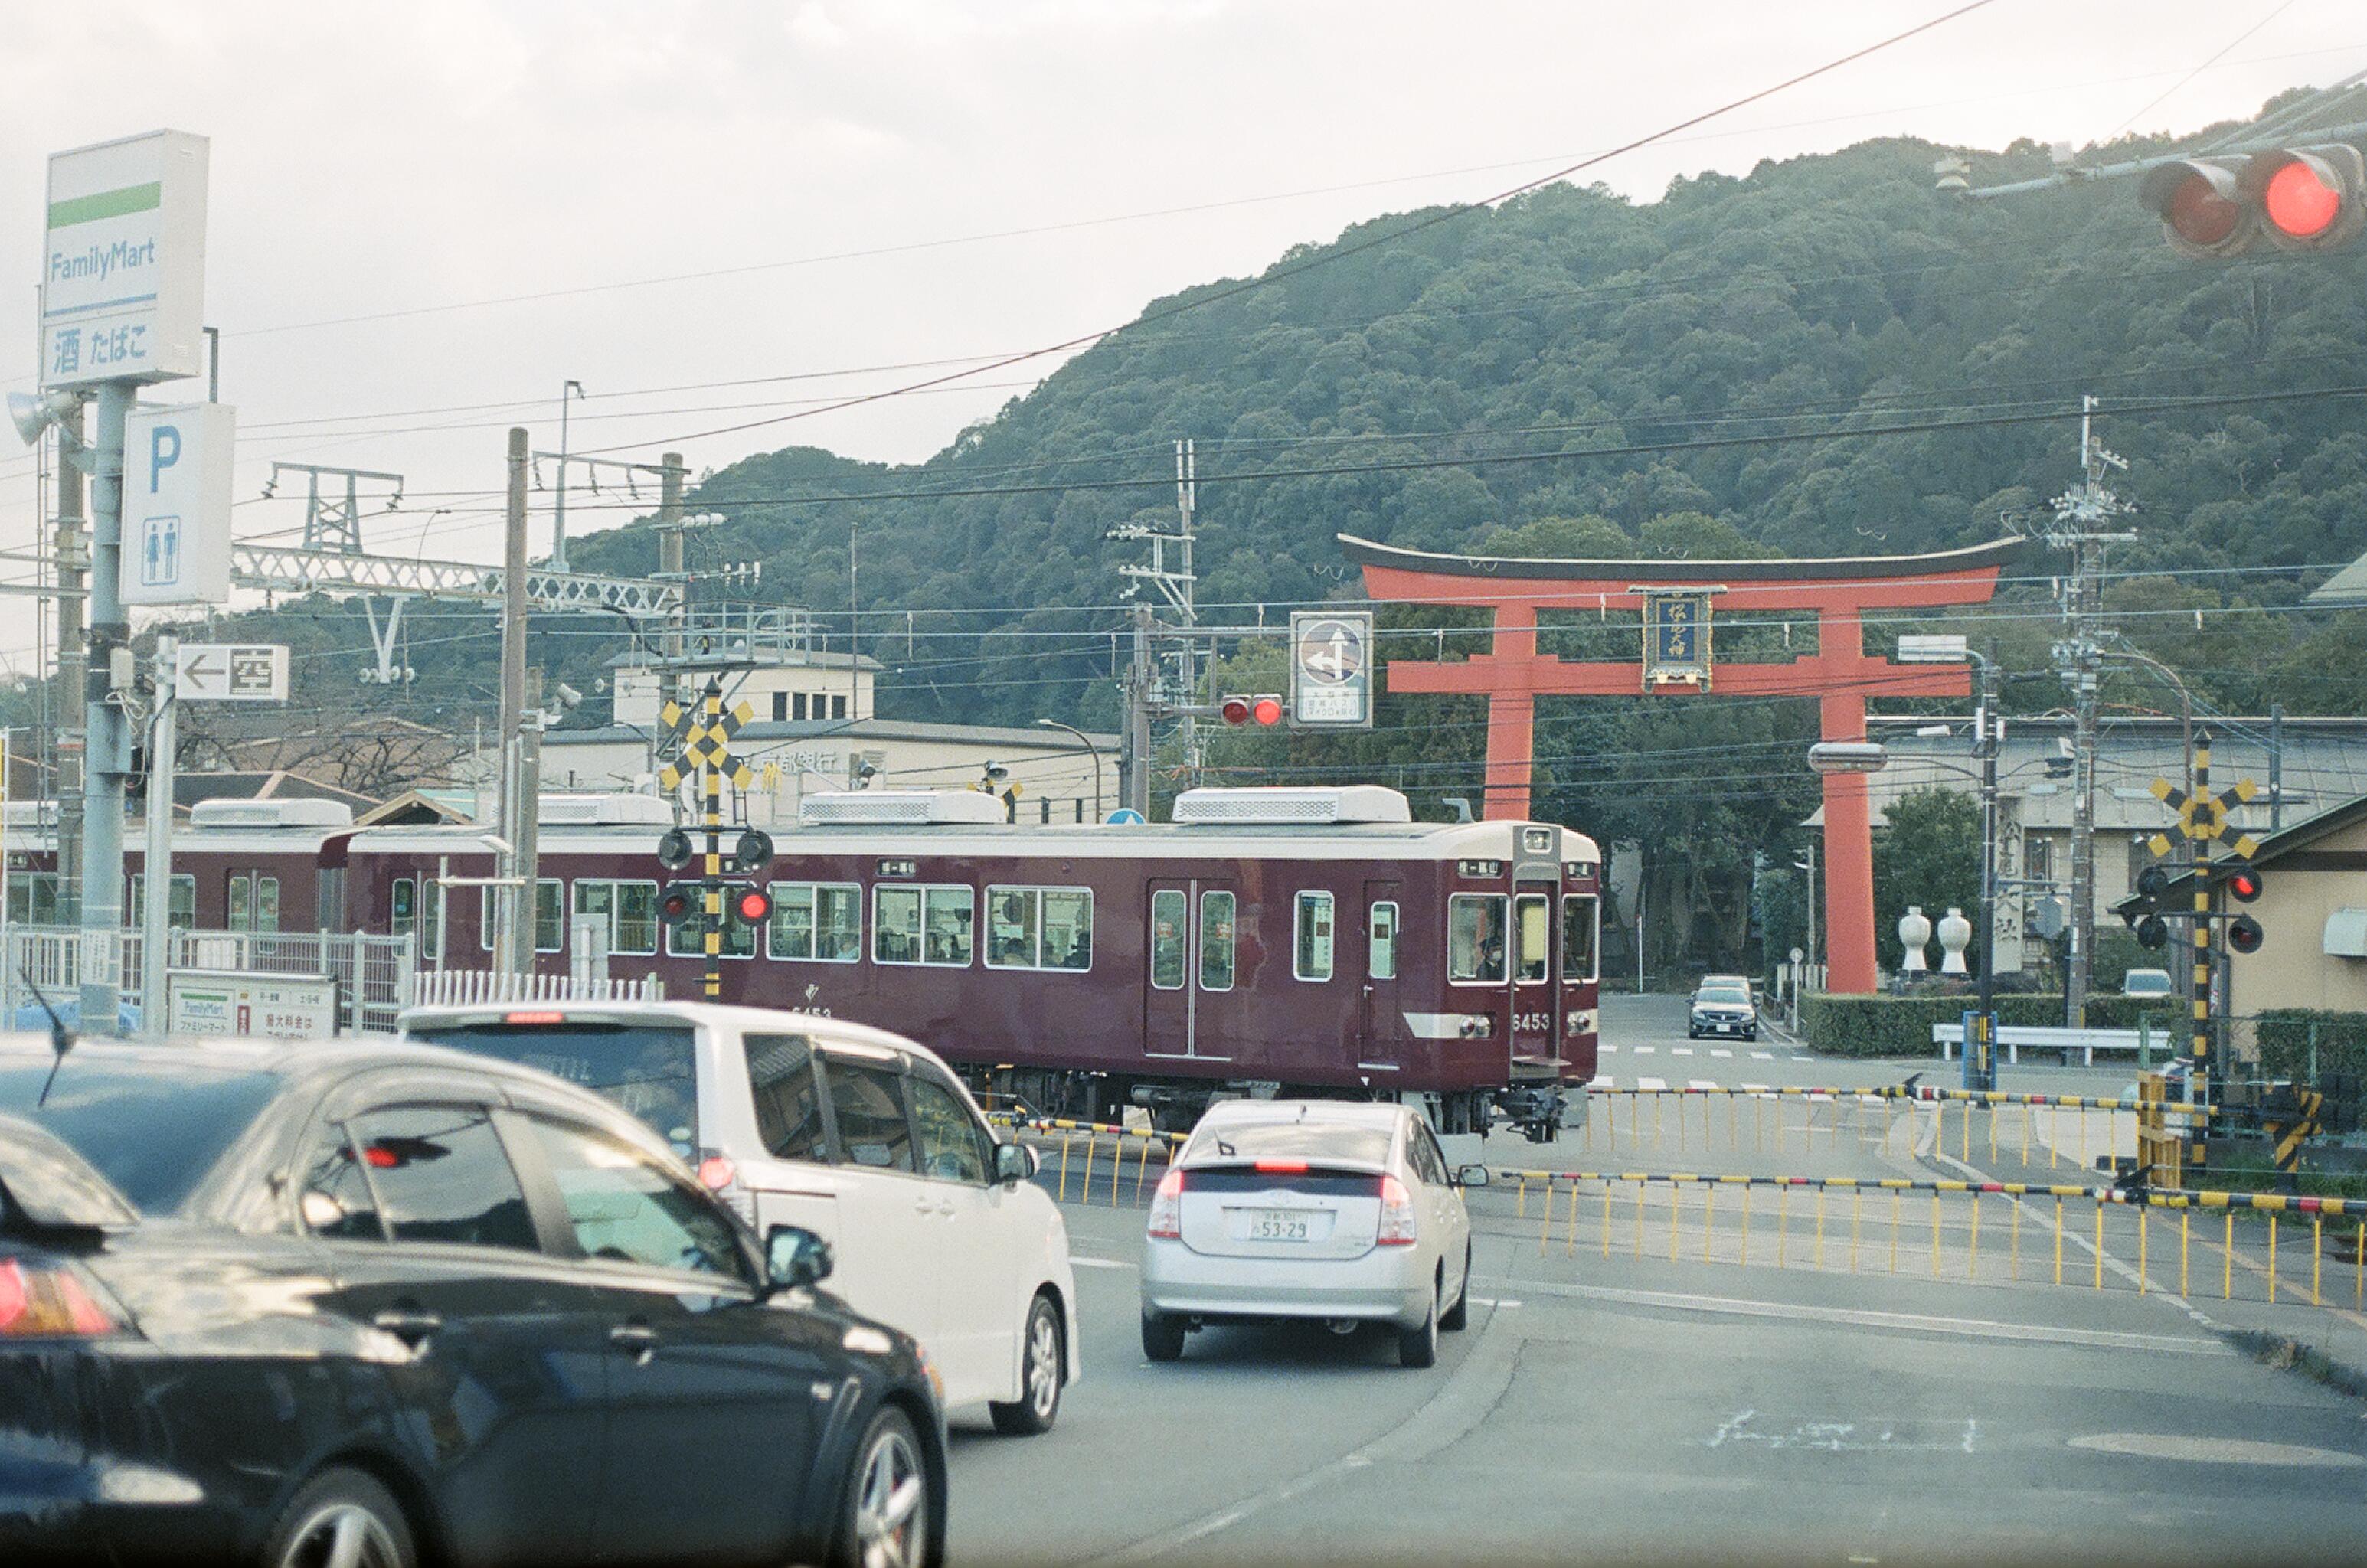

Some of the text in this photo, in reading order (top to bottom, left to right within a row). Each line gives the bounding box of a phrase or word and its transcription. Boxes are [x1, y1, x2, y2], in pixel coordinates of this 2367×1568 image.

[51, 237, 155, 282] FamilyMart
[54, 325, 147, 374] 酒 たばこ
[150, 425, 182, 494] P
[184, 1001, 224, 1016] FamilyMart
[1512, 1013, 1550, 1031] 6453
